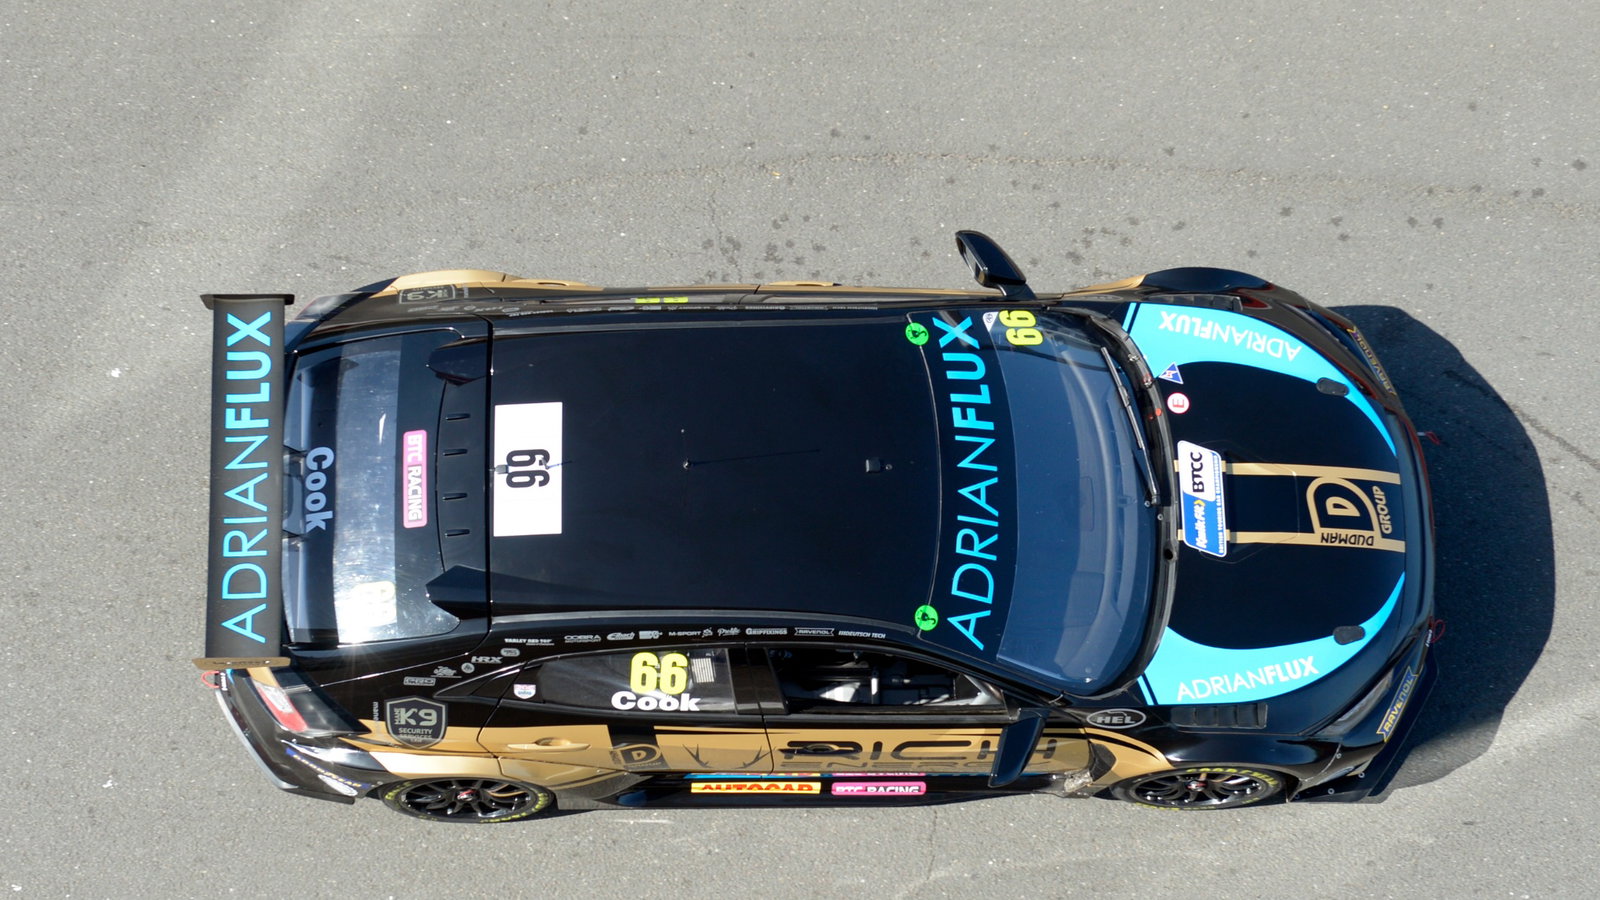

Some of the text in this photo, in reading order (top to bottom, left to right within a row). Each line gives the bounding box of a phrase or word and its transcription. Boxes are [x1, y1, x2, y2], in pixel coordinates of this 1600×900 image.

[999, 310, 1044, 346] 66
[1158, 311, 1302, 361] ADRIANFLUX
[221, 311, 272, 644] ADRIANFLUX
[304, 445, 334, 532] Cook
[407, 433, 423, 521] BTC RACING
[506, 449, 550, 488] 66
[932, 316, 999, 651] ADRIANFLUX
[1190, 452, 1204, 493] BTCC
[1371, 485, 1393, 534] GROUP
[1320, 532, 1375, 547] DUDMAN
[471, 656, 503, 664] HRX
[630, 652, 689, 695] 66
[1177, 656, 1319, 701] ADRIANFLUX
[400, 708, 437, 726] K9
[611, 691, 701, 711] Cook
[1097, 715, 1136, 724] HEL
[1383, 675, 1415, 732] RAVENOL
[398, 727, 433, 735] SECURITY
